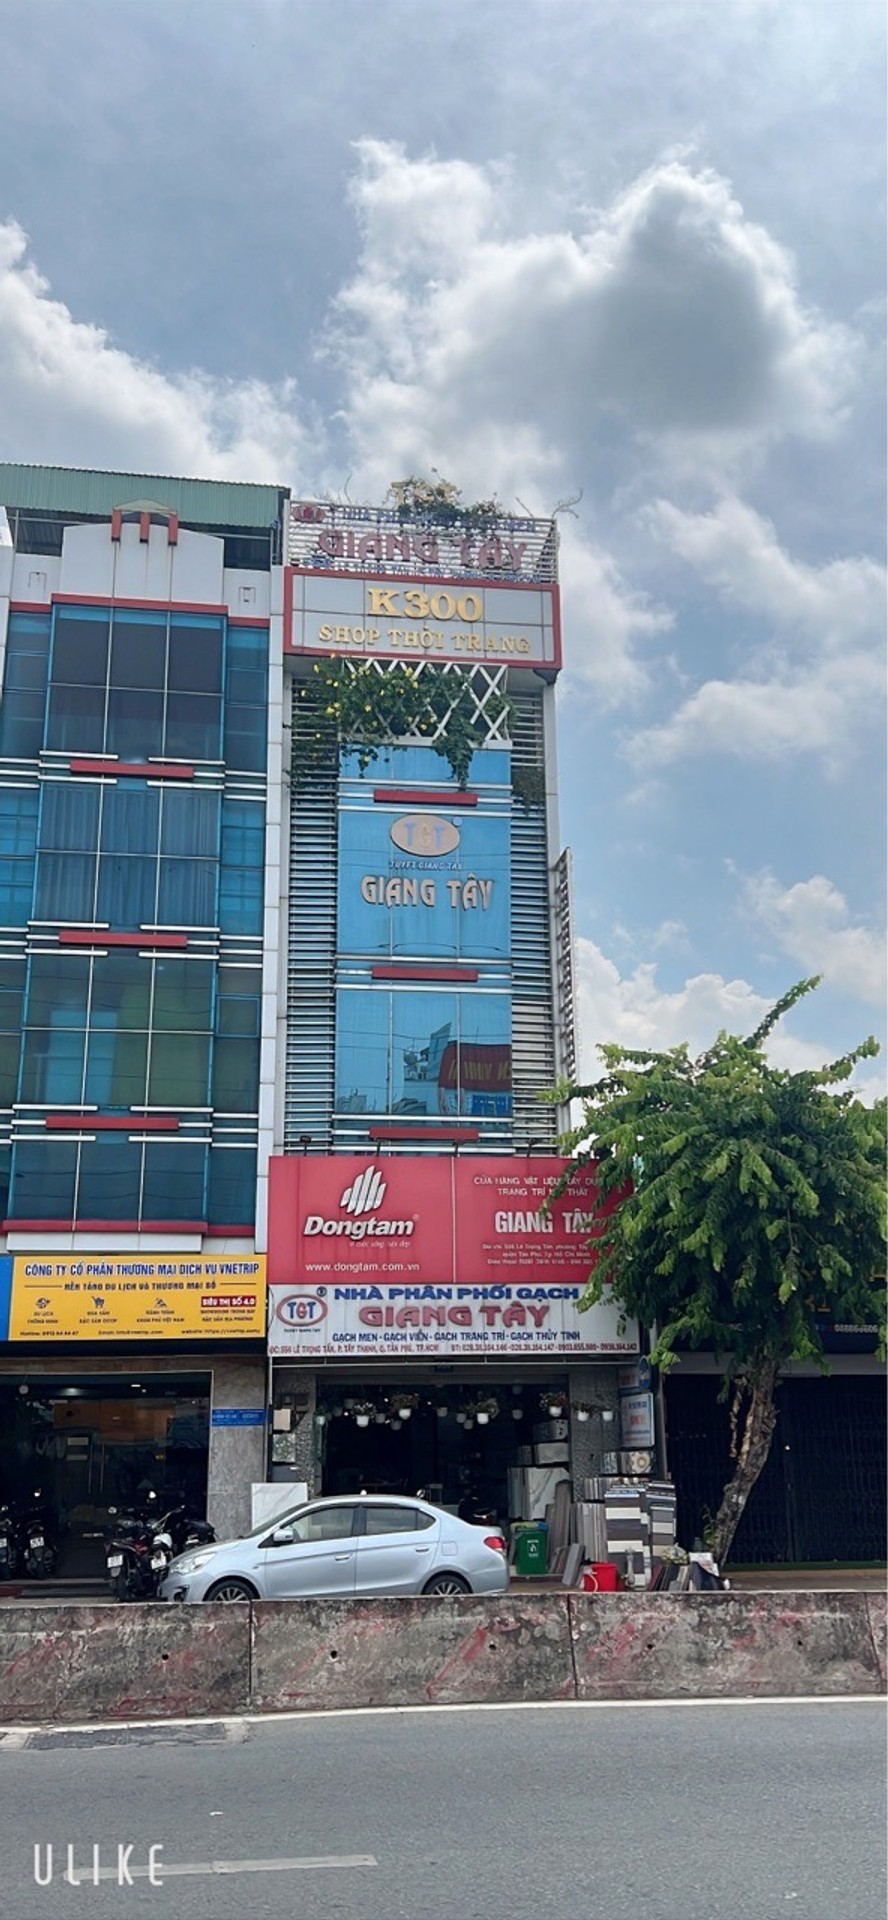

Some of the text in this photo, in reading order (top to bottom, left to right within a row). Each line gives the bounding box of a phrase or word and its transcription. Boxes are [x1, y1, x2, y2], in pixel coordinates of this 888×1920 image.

[318, 528, 439, 563] GIANG
[368, 587, 483, 622] K300
[319, 624, 531, 655] SHOP THỜI TRANG
[361, 872, 494, 912] GIANG TÂY
[498, 1187, 528, 1197] TRANG
[531, 1186, 546, 1196] TRÍ
[303, 1215, 415, 1240] Dongtam
[495, 1208, 594, 1234] GIANG TÂY
[25, 1262, 52, 1276] CÔNG
[56, 1264, 67, 1276] TY
[116, 1264, 155, 1276] THƯƠNG
[157, 1264, 177, 1278] MẠI
[179, 1263, 202, 1277] DỊCH
[220, 1262, 260, 1275] VNETRIP
[305, 1263, 420, 1274] www.dongtam.com.vn
[334, 1284, 580, 1303] NHÀ PHÂN PHỐI GẠCH
[287, 1301, 317, 1320] TGT
[359, 1301, 551, 1329] GIANG TÂY
[332, 1332, 357, 1344] GẠCH
[358, 1332, 378, 1342] MEN
[383, 1332, 408, 1344] GẠCH
[434, 1331, 457, 1343] GẠCH
[460, 1331, 489, 1342] TRANG
[491, 1330, 505, 1341] TRÍ
[510, 1331, 533, 1343] GẠCH
[560, 1330, 581, 1341] TINH
